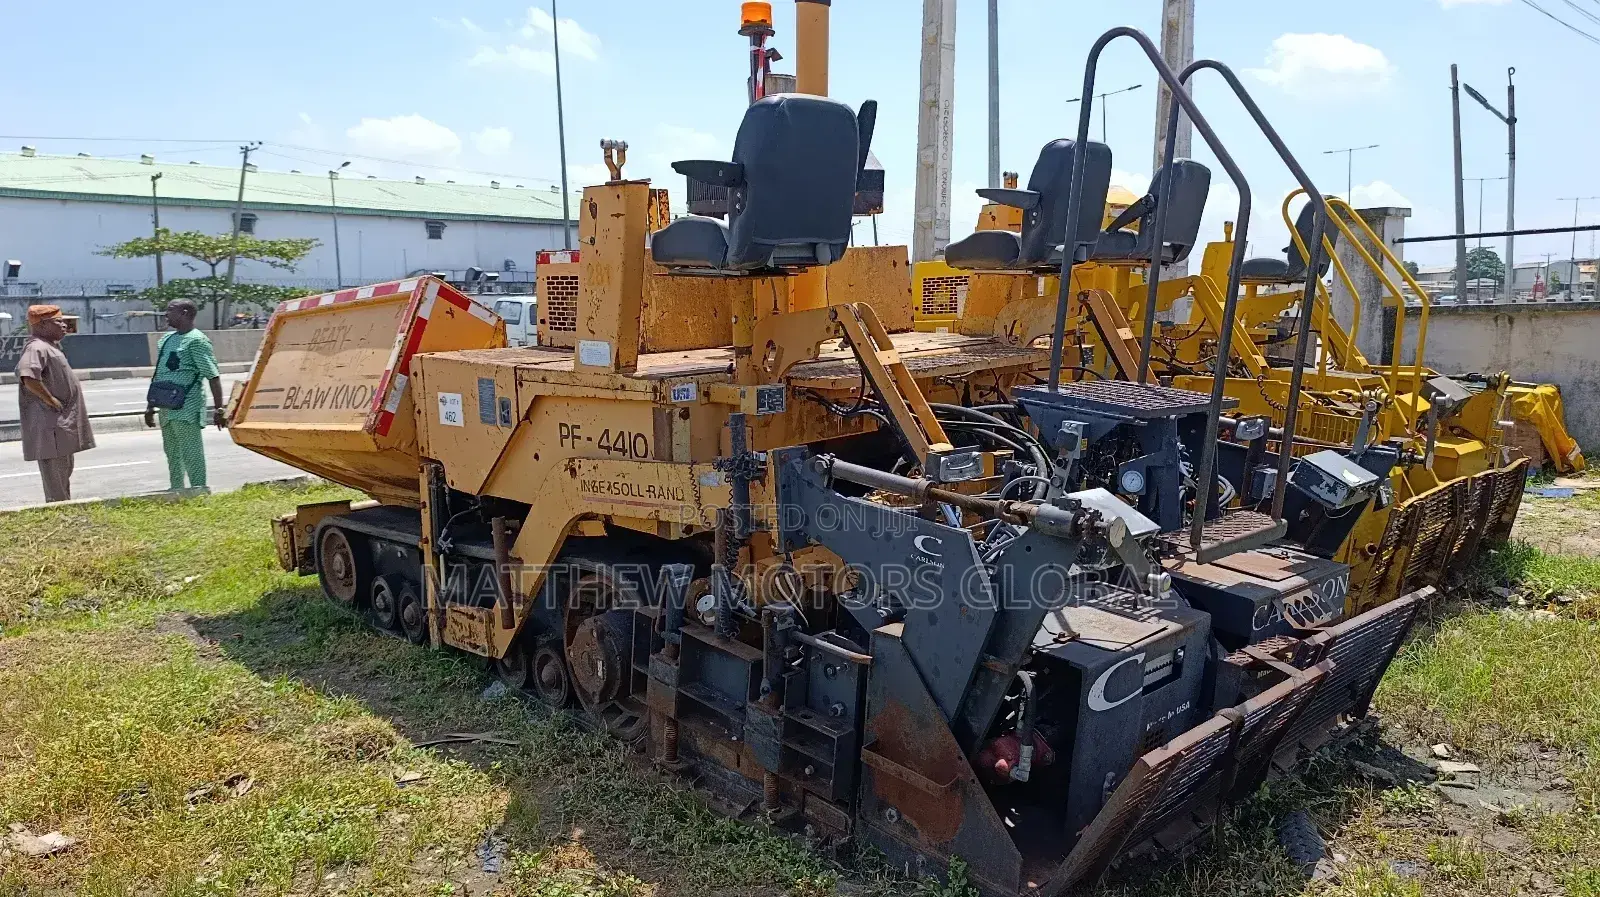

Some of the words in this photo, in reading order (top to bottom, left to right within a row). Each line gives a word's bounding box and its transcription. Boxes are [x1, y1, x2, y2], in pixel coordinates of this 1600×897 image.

[283, 386, 331, 410] BLAW
[329, 384, 379, 410] KNOX
[445, 411, 457, 423] 462
[1176, 700, 1190, 715] USA
